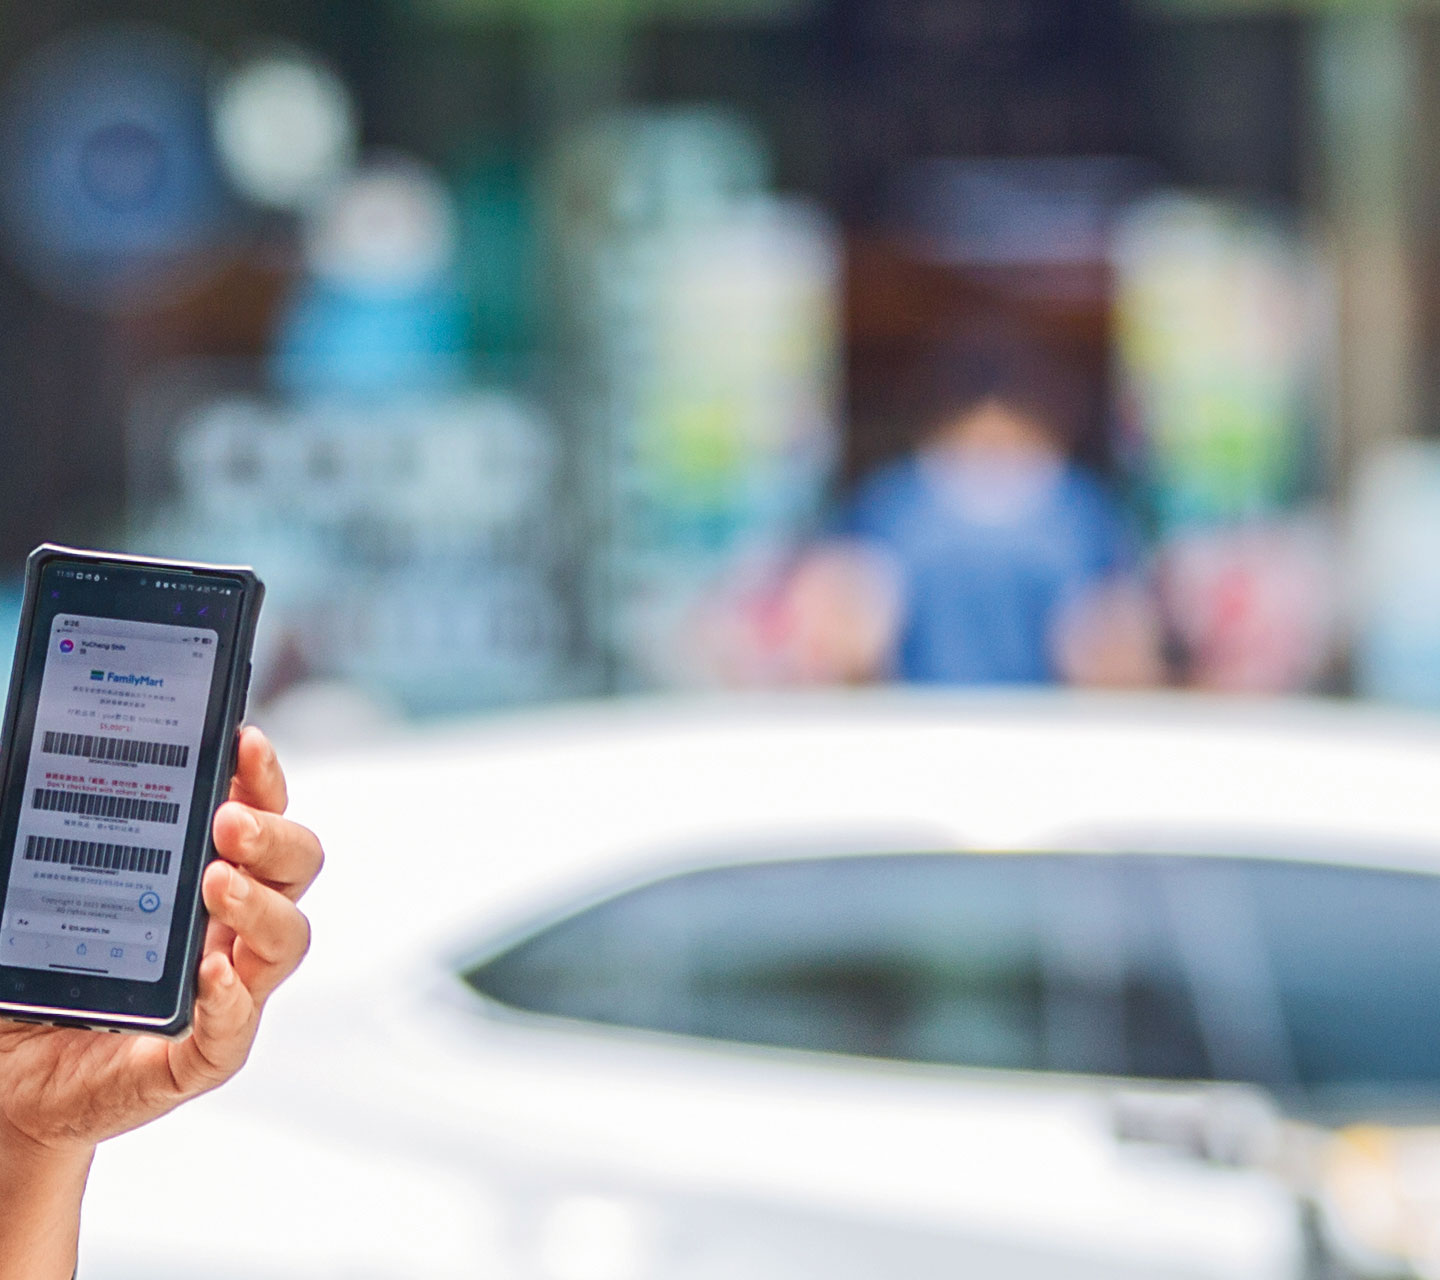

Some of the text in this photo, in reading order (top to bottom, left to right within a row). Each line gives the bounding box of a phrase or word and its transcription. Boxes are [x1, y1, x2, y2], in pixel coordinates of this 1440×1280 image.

[107, 672, 164, 687] FamilyMart
[67, 783, 96, 791] checkout
[41, 896, 75, 907] Copyright
